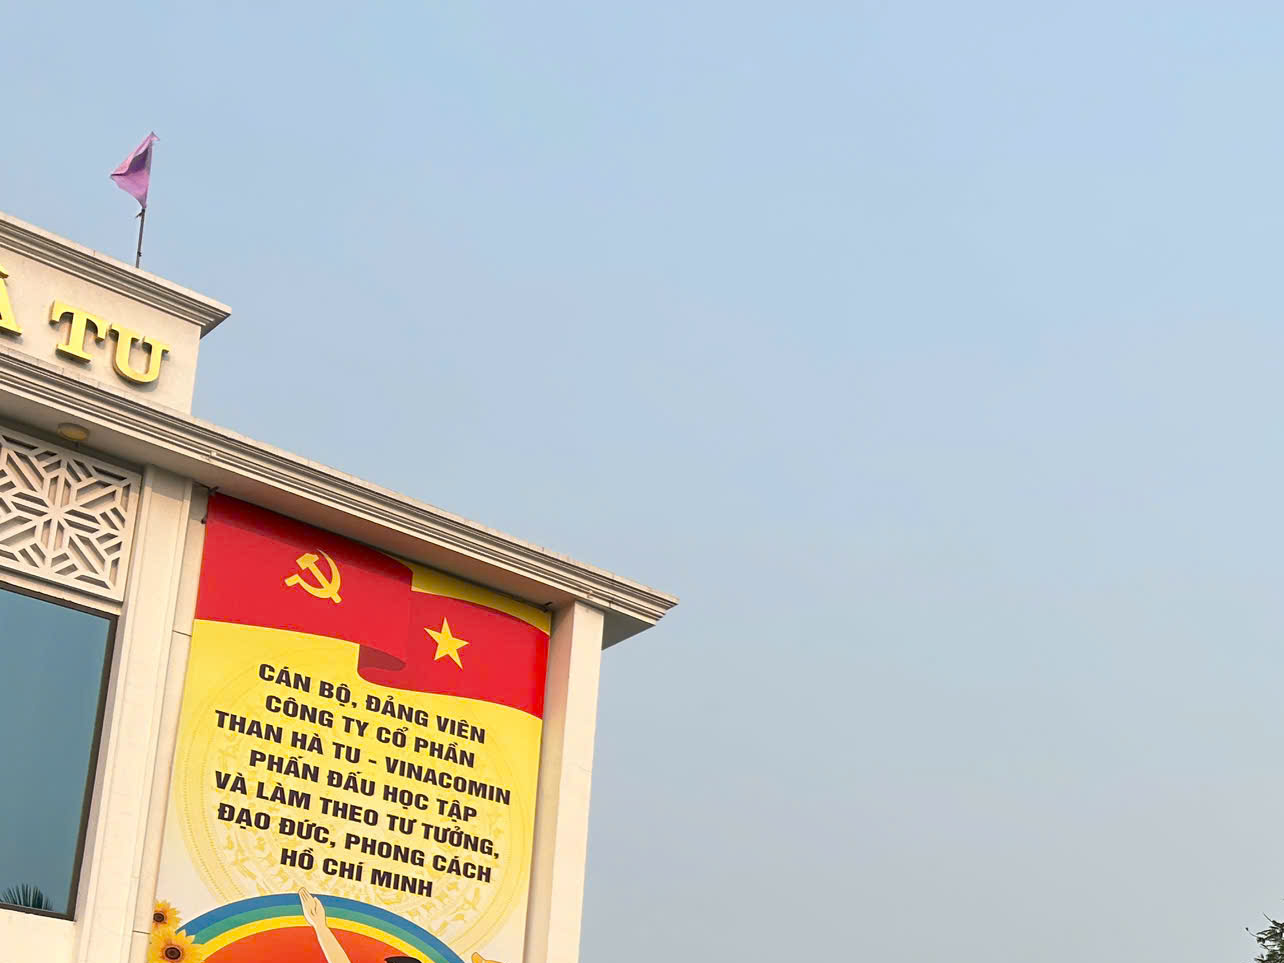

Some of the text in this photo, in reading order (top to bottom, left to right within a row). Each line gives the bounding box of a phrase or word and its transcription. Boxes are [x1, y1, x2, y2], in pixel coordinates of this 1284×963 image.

[49, 299, 170, 383] TU
[259, 664, 485, 744] CÁN BỘ, ĐẢNG VIÊN
[266, 695, 475, 768] CÔNG TY CỔ PHẦN
[215, 710, 283, 744] THAN
[291, 731, 323, 755] HÀ
[333, 742, 360, 763] TU
[385, 756, 510, 805] VINACOMIN
[249, 750, 477, 822] PHẤN ĐẤU HỌC TẬP
[215, 771, 499, 859] VÀ LÀM THEO TƯ TƯỞNG,
[218, 802, 491, 883] ĐẠO ĐỨC, PHONG CÁCH
[280, 848, 433, 897] HỒ CHÍ MINH
